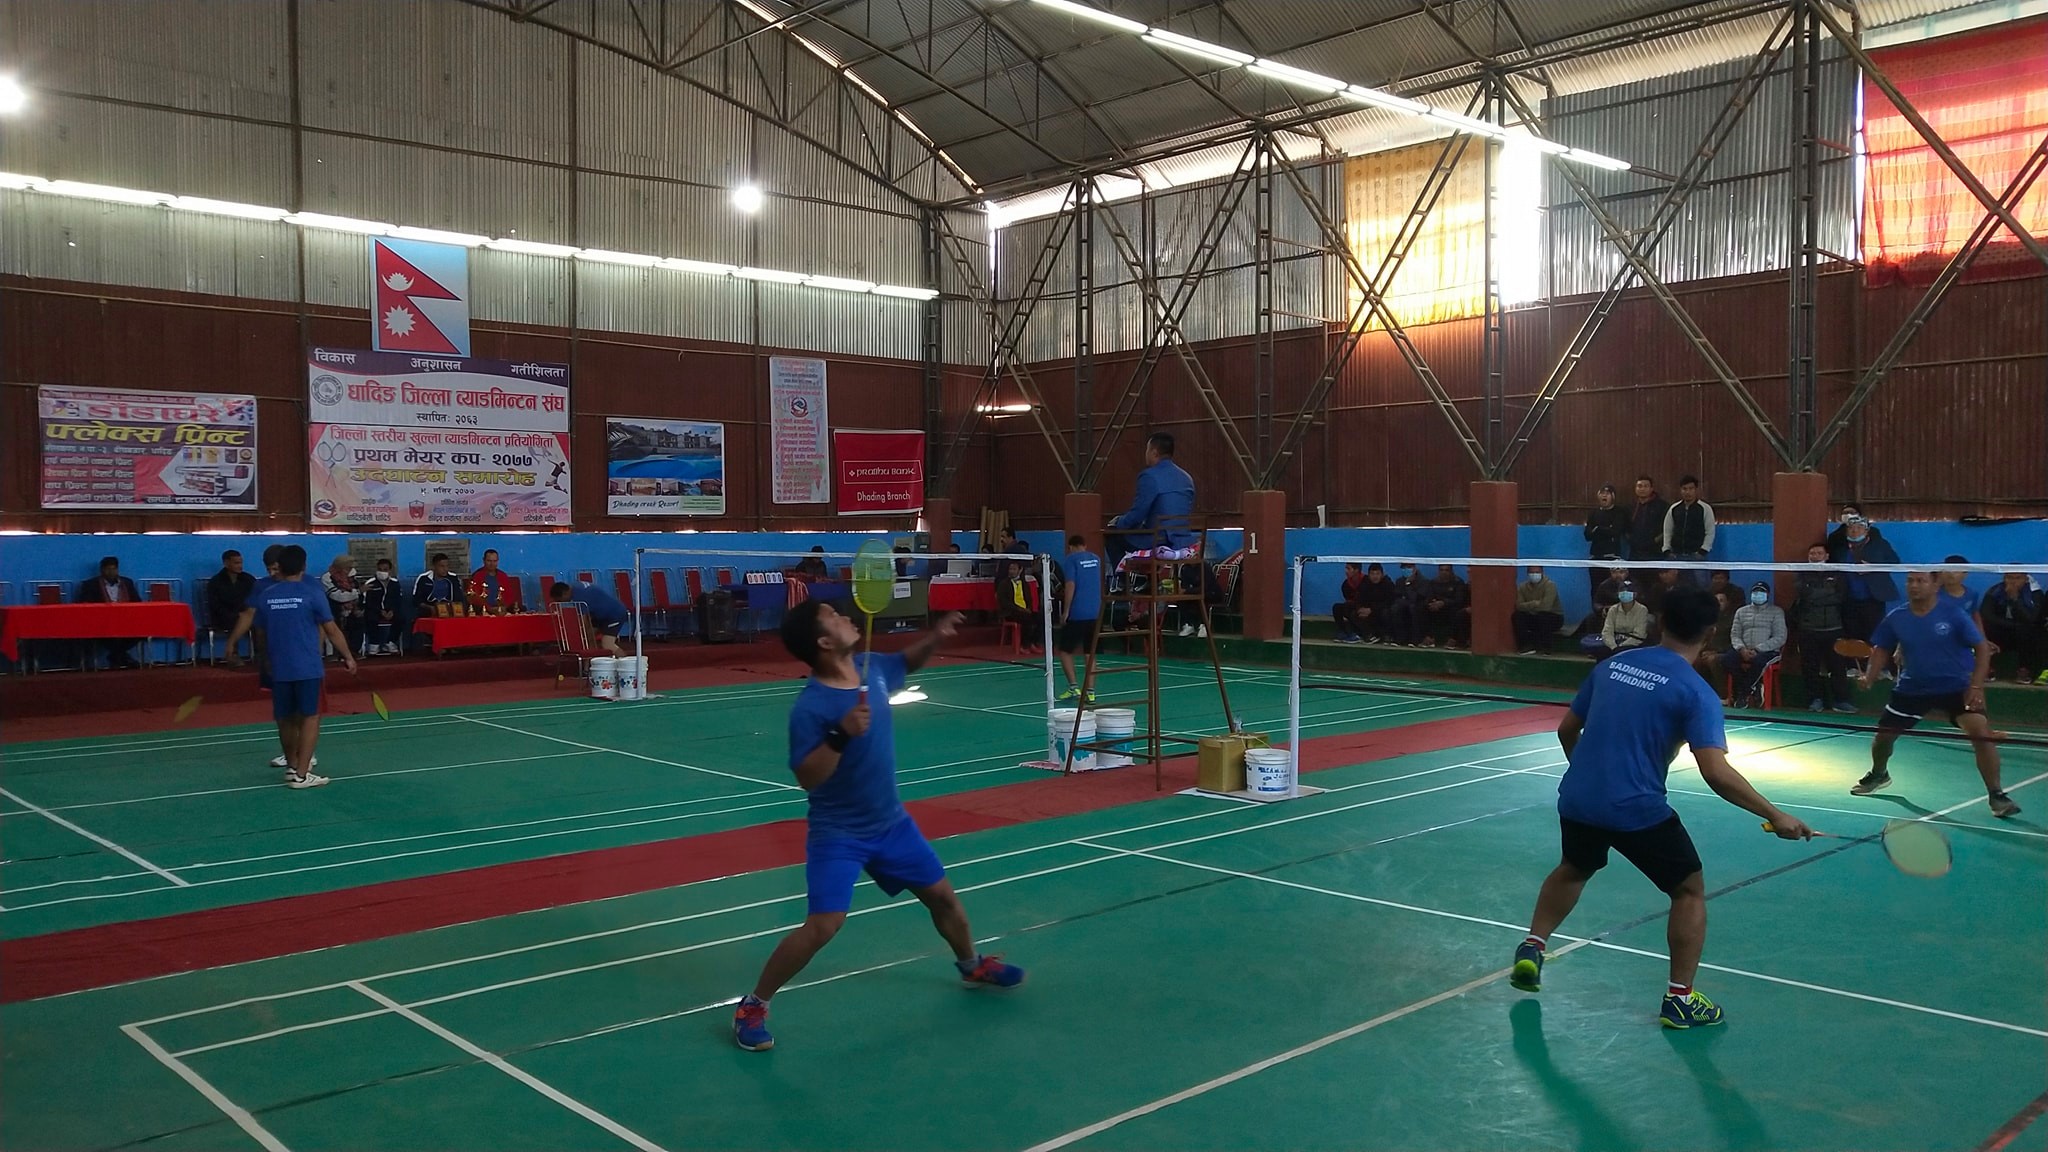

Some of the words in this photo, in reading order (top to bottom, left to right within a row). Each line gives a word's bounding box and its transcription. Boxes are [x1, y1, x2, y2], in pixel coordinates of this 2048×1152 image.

[315, 348, 356, 364] विकास
[410, 358, 462, 371] अनुशासन
[510, 364, 565, 378] गतीशिलता
[348, 380, 396, 404] धादिङ
[401, 382, 452, 406] जिल्ला
[542, 393, 565, 412] संघ
[455, 415, 478, 425] २०६३
[46, 420, 166, 443] फ्लेक्स
[174, 424, 250, 445] प्रिन्ट
[330, 427, 367, 441] जिल्ला
[372, 428, 405, 442] स्तरीय
[410, 432, 440, 444] खुल्ला
[504, 433, 553, 448] प्रतियोगिता
[354, 449, 397, 462] प्रथम
[404, 448, 446, 464] मेयर
[492, 454, 533, 466] २०७७
[454, 468, 537, 486] समारोह
[857, 491, 886, 503] Dhading
[887, 490, 910, 500] Branch
[1250, 532, 1258, 554] 1
[1609, 661, 1670, 685] BADMINTON
[1610, 671, 1656, 691] DHADING
